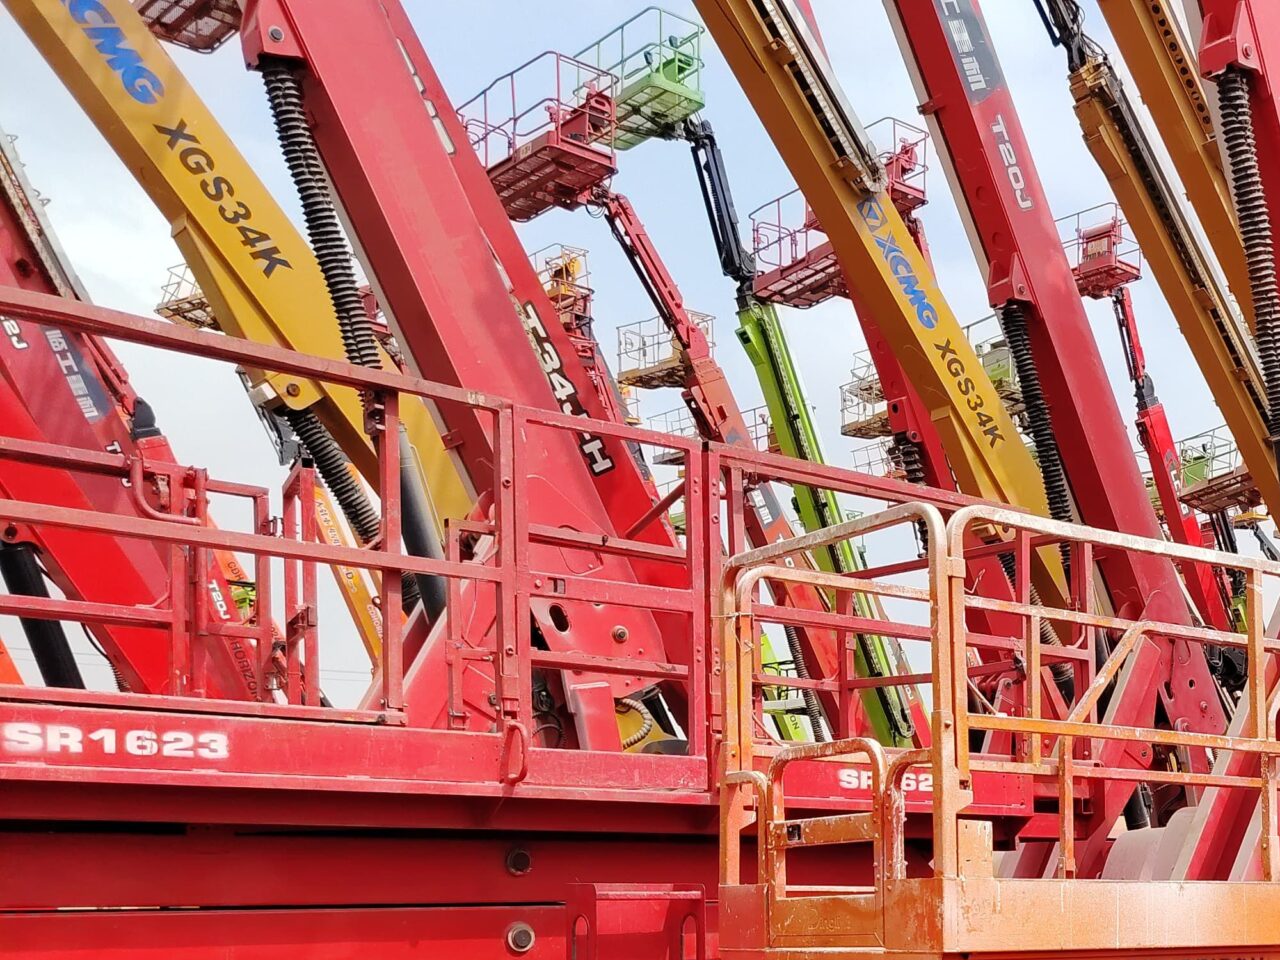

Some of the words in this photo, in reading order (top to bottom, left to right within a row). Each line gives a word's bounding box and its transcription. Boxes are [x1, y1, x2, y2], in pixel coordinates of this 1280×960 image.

[66, 0, 165, 105] CMG
[153, 118, 293, 279] XGS34K
[991, 114, 1033, 210] T20J
[45, 328, 99, 419] 临工重机
[872, 229, 939, 331] XCMG
[933, 338, 1005, 449] XGS34K
[208, 579, 231, 620] T20J
[3, 722, 230, 760] SR1623
